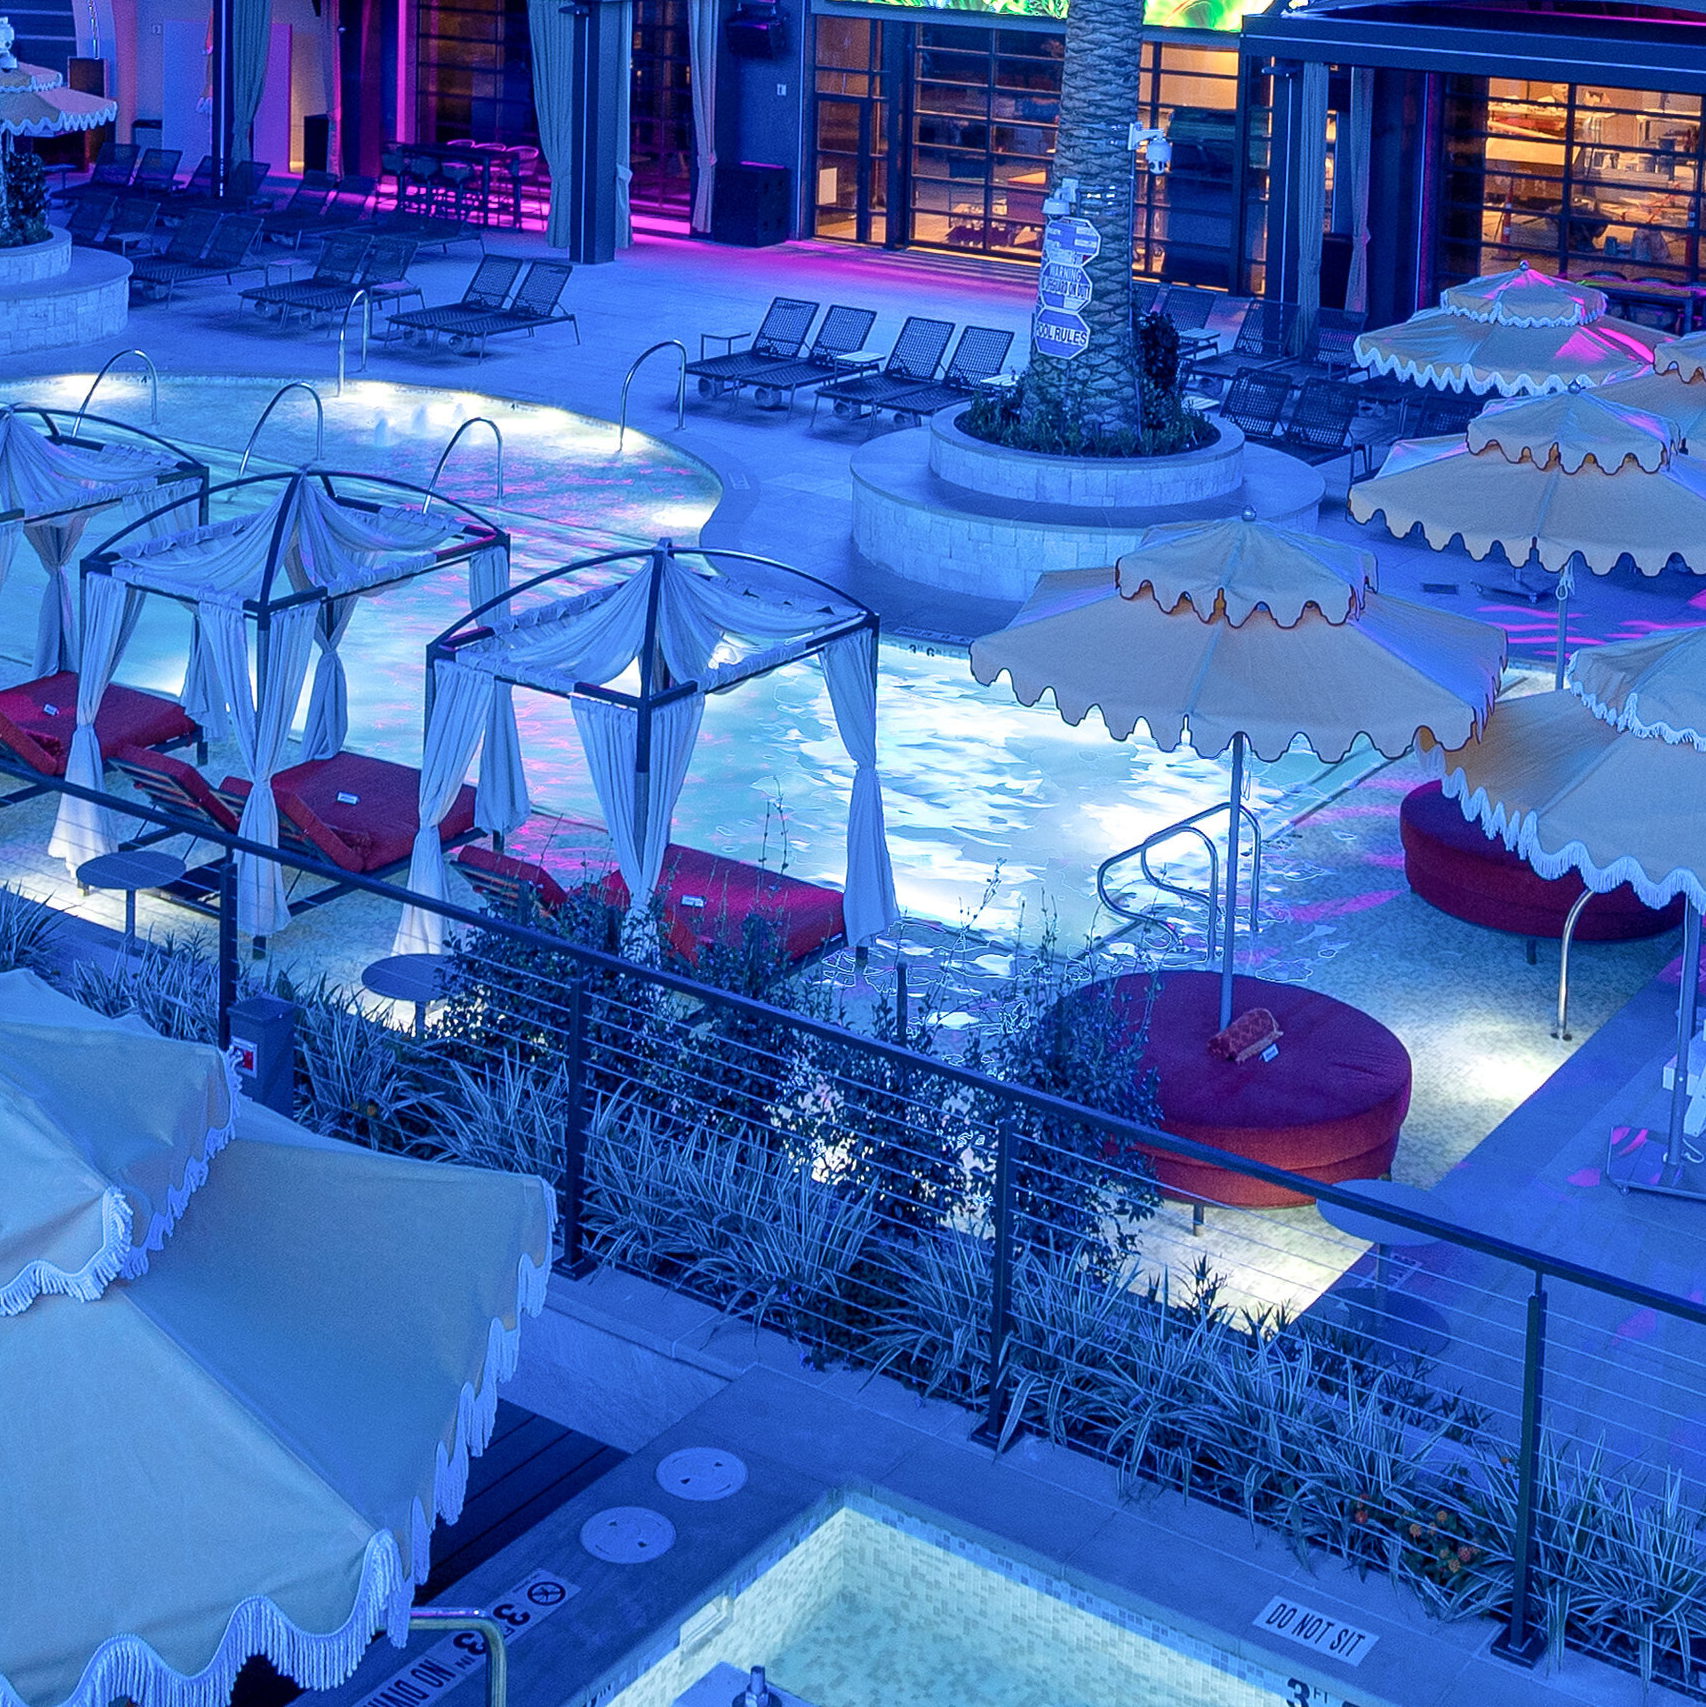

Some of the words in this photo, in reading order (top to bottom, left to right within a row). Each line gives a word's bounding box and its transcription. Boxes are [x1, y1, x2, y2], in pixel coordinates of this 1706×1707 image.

[1055, 327, 1087, 345] RULES
[493, 1603, 530, 1626] 3
[1265, 1602, 1298, 1629] DO
[1291, 1612, 1336, 1645] NOT
[1329, 1628, 1366, 1657] SIT
[453, 1632, 486, 1656] 3
[410, 1658, 457, 1688] NO
[1286, 1677, 1311, 1707] 3
